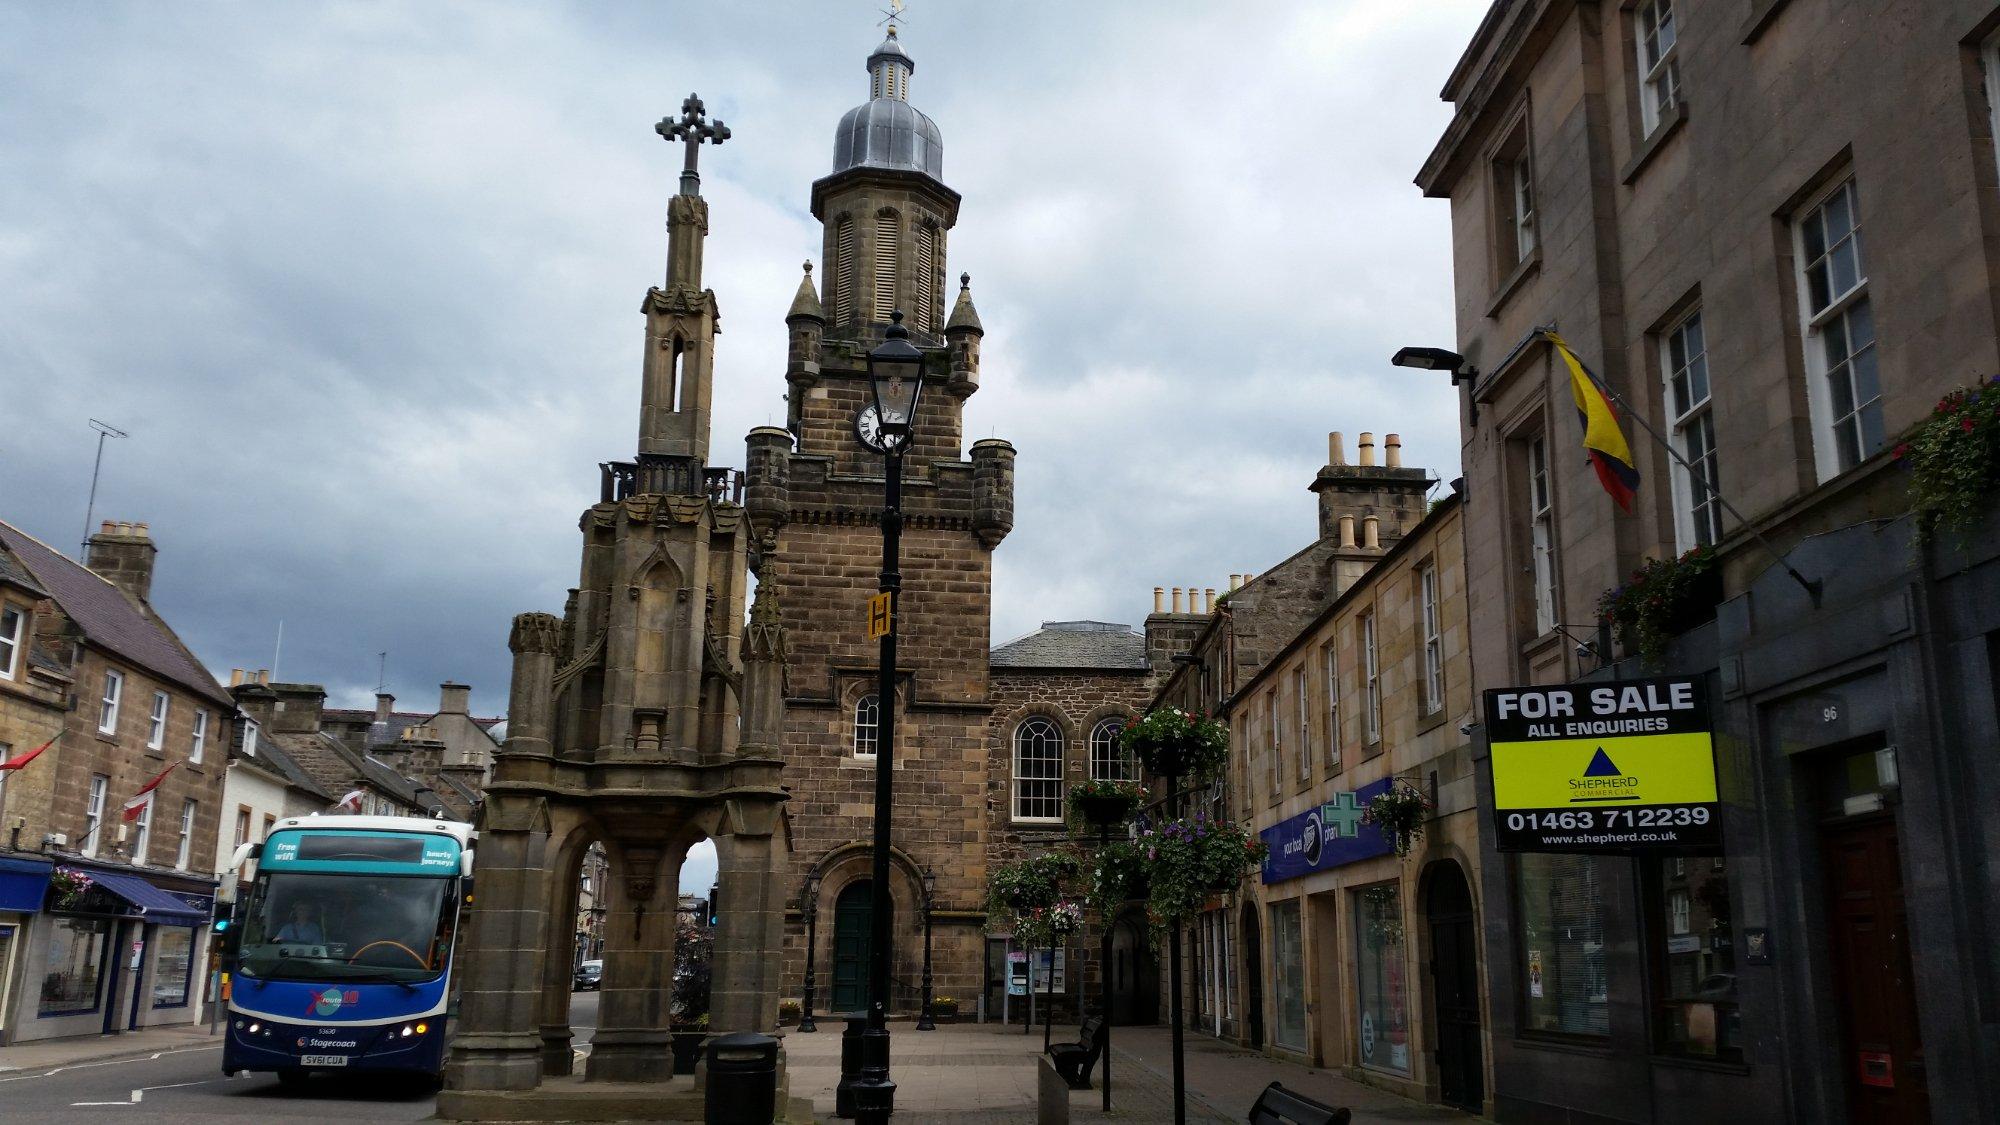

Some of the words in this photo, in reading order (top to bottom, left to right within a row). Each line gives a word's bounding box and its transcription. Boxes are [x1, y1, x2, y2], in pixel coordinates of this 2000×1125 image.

[872, 597, 887, 634] H
[1497, 691, 1575, 720] FOR
[1591, 682, 1695, 715] SALE
[1824, 706, 1837, 722] 96
[1527, 723, 1561, 738] ALL
[1566, 717, 1669, 736] ENQUIRIES
[1569, 776, 1638, 790] SHEPHERD
[1573, 788, 1636, 798] COMMERCIAL
[1507, 811, 1594, 831] 01463
[1602, 807, 1710, 829] 712239
[1293, 834, 1302, 853] local
[1542, 831, 1677, 845] www.shepherd.co.uk
[309, 1038, 357, 1049] Stagecoach
[306, 1055, 325, 1064] SV61
[326, 1056, 343, 1065] CUA
